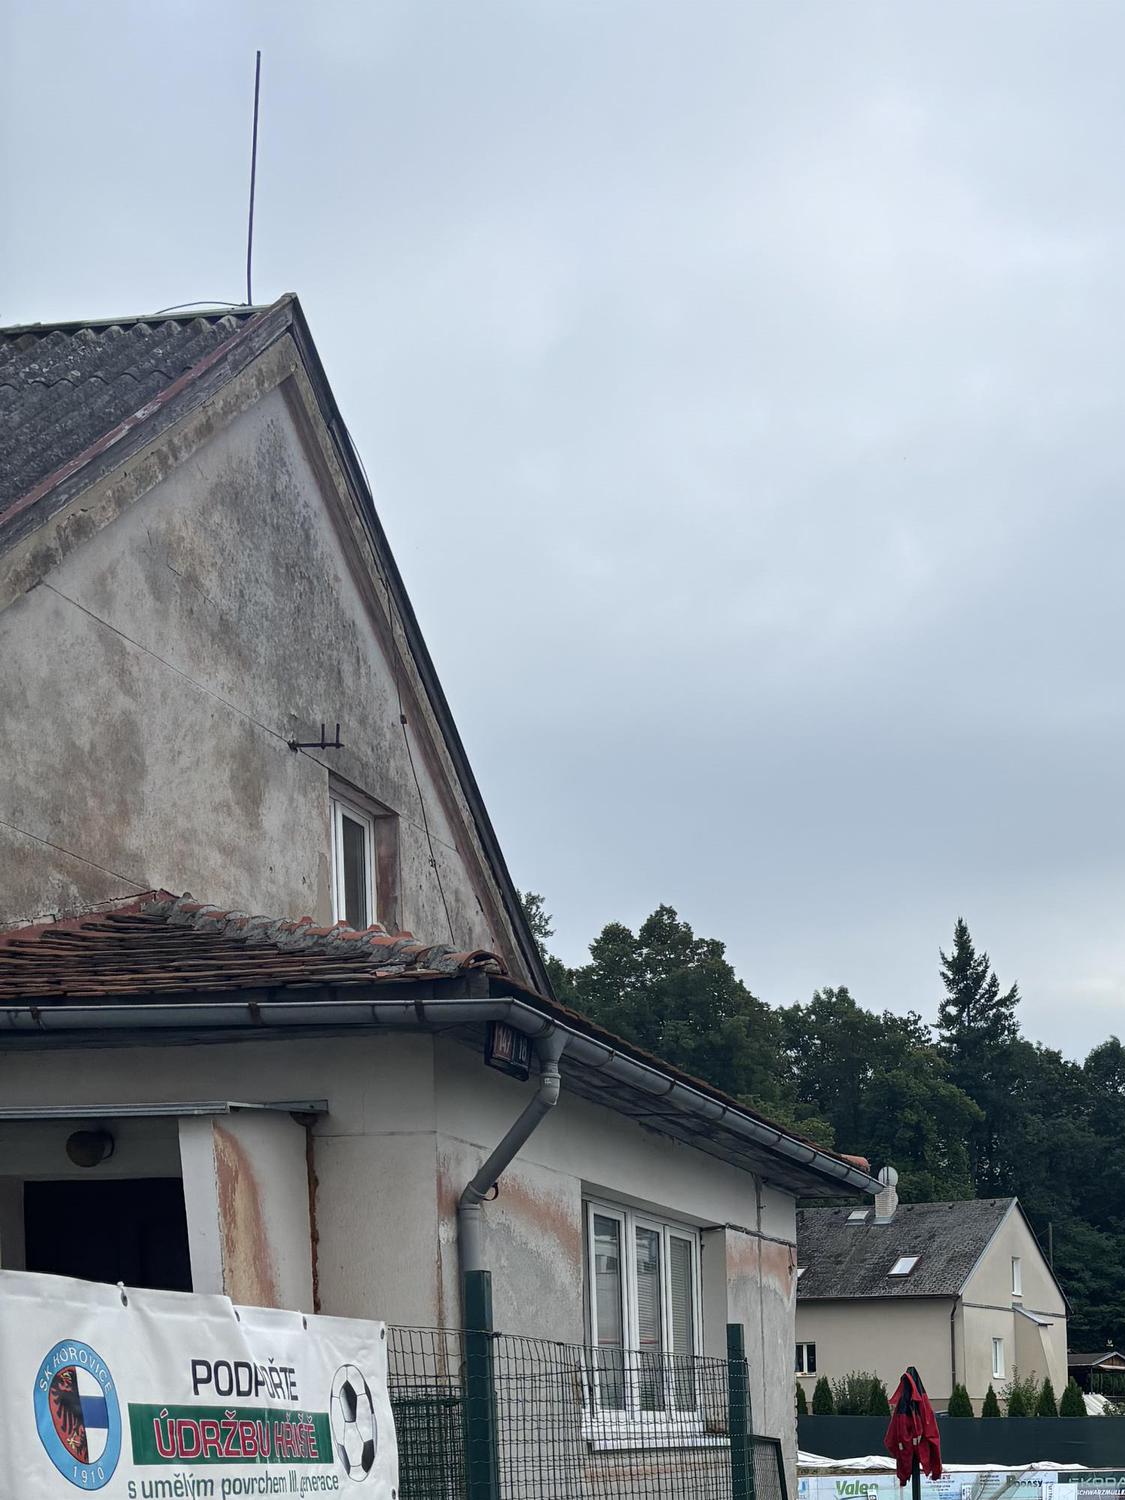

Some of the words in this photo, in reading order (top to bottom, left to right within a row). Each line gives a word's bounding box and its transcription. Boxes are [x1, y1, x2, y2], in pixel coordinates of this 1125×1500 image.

[39, 1369, 53, 1392] SK
[154, 1409, 270, 1459] ÚDRŽBU
[73, 1466, 105, 1484] 1910
[128, 1480, 137, 1498] s
[300, 1474, 339, 1498] generace
